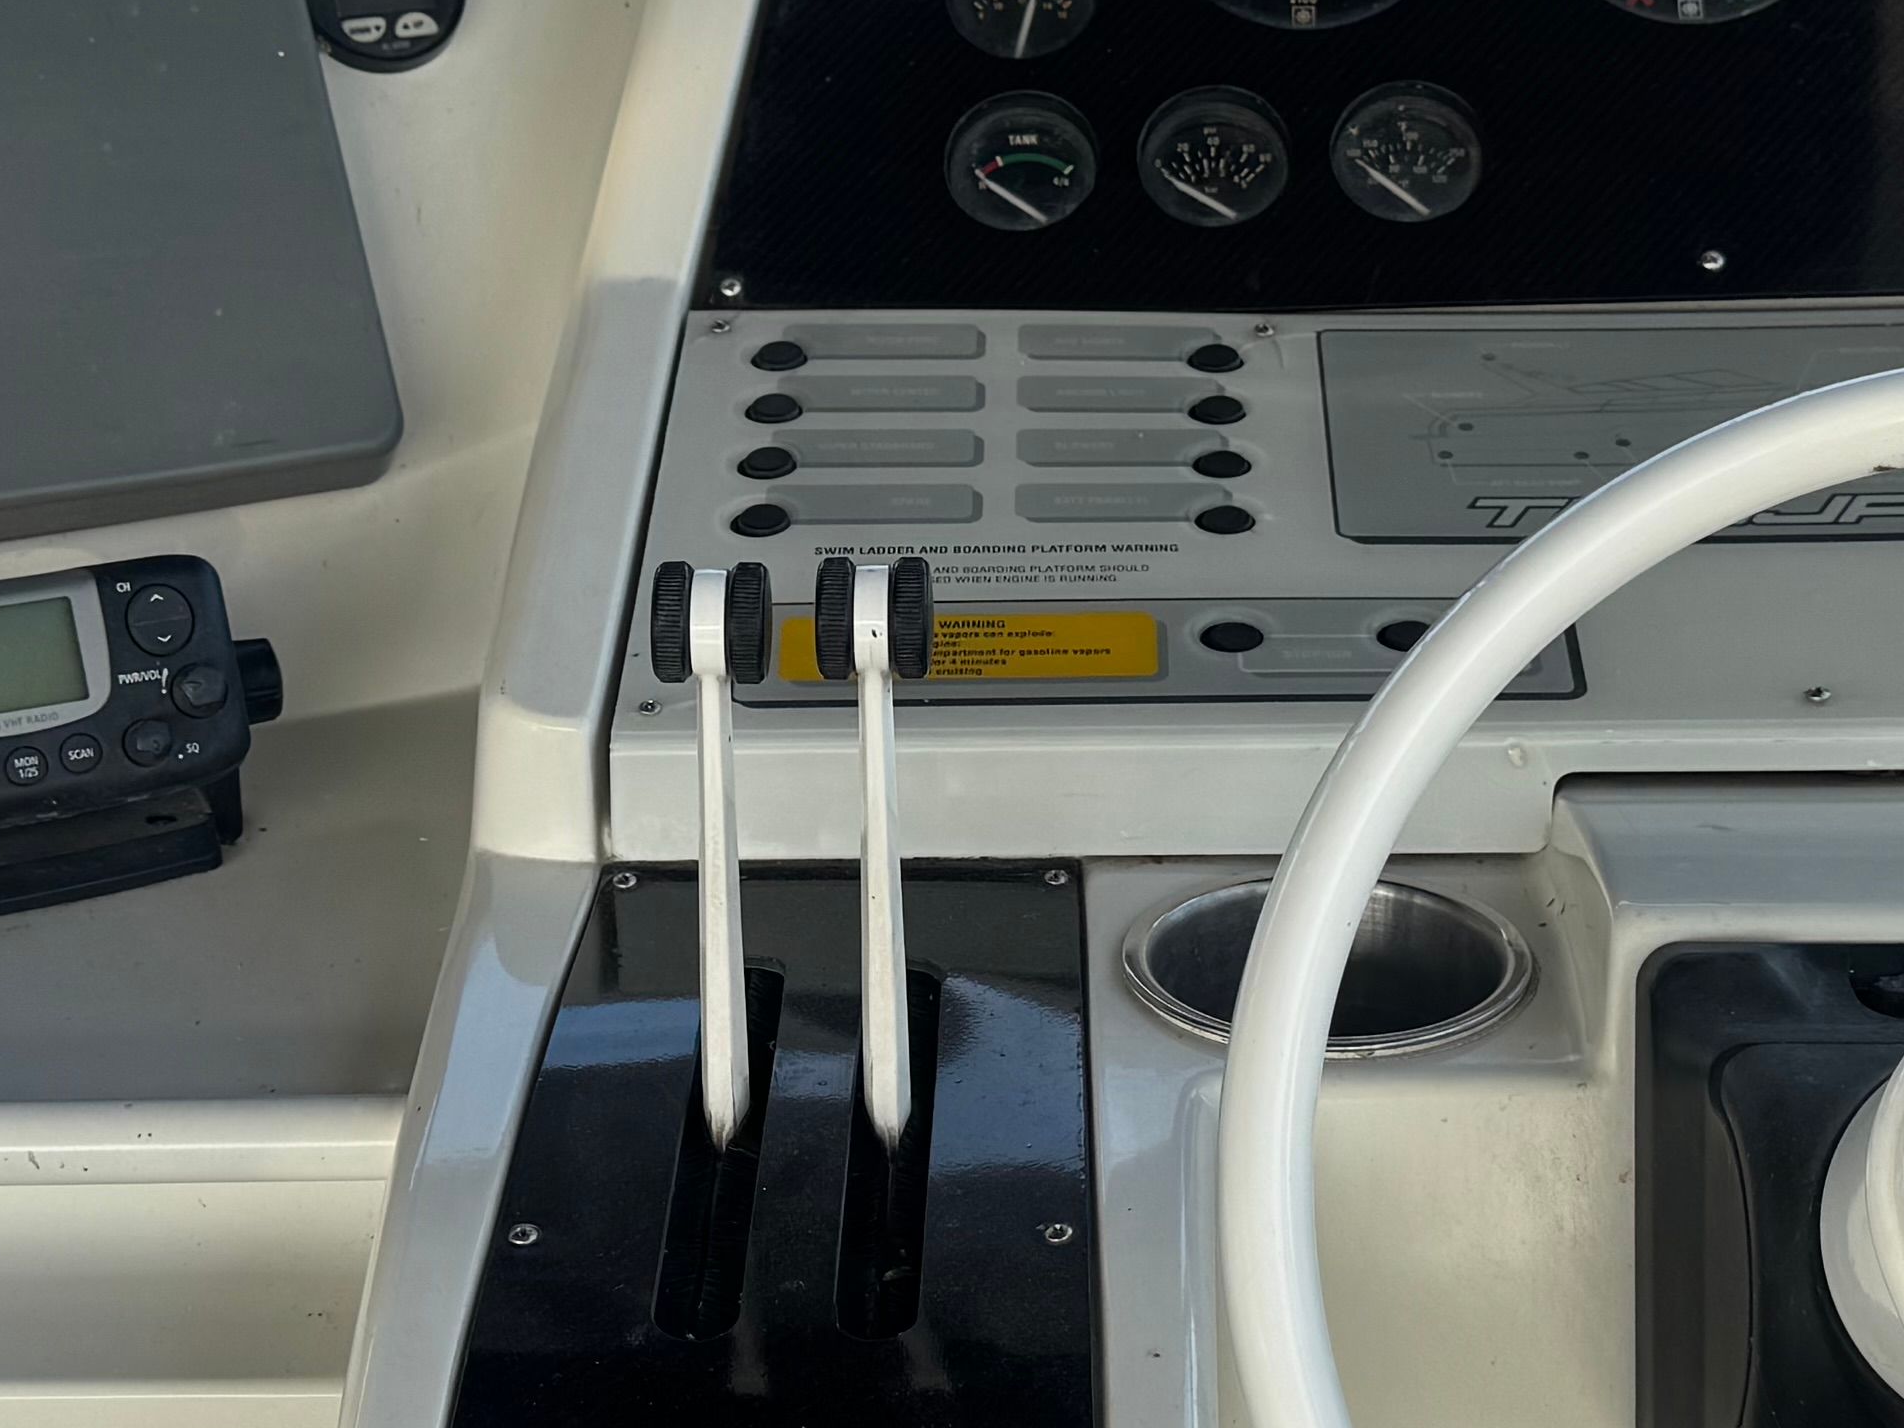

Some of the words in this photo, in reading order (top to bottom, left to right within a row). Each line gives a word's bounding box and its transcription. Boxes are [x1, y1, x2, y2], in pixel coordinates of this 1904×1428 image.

[1008, 134, 1039, 145] TANK
[814, 546, 855, 556] SWIM
[859, 546, 914, 555] LADDER
[919, 545, 948, 555] AND
[953, 545, 1027, 555] BOARDING
[1031, 544, 1107, 554] PLATFORM
[1111, 544, 1179, 553] WARNING
[934, 565, 959, 574] AND
[962, 564, 1026, 574] BOARDING
[1030, 564, 1096, 573] PLATFORM
[1099, 563, 1149, 572] SHOULD
[955, 575, 991, 584] WHEN
[995, 575, 1040, 584] ENGINE
[1044, 574, 1056, 583] IS
[1060, 574, 1117, 583] RUNNING
[939, 620, 1006, 629] WARNING
[941, 632, 980, 640] vapors
[999, 648, 1015, 656] for
[1019, 648, 1069, 657] gasoline
[1072, 648, 1111, 656] vapors
[960, 657, 1007, 666] minutes
[936, 667, 983, 676] cruising
[27, 711, 60, 727] RADIO
[185, 742, 201, 754] SQ
[67, 747, 95, 761] SCAN
[14, 755, 39, 769] MON
